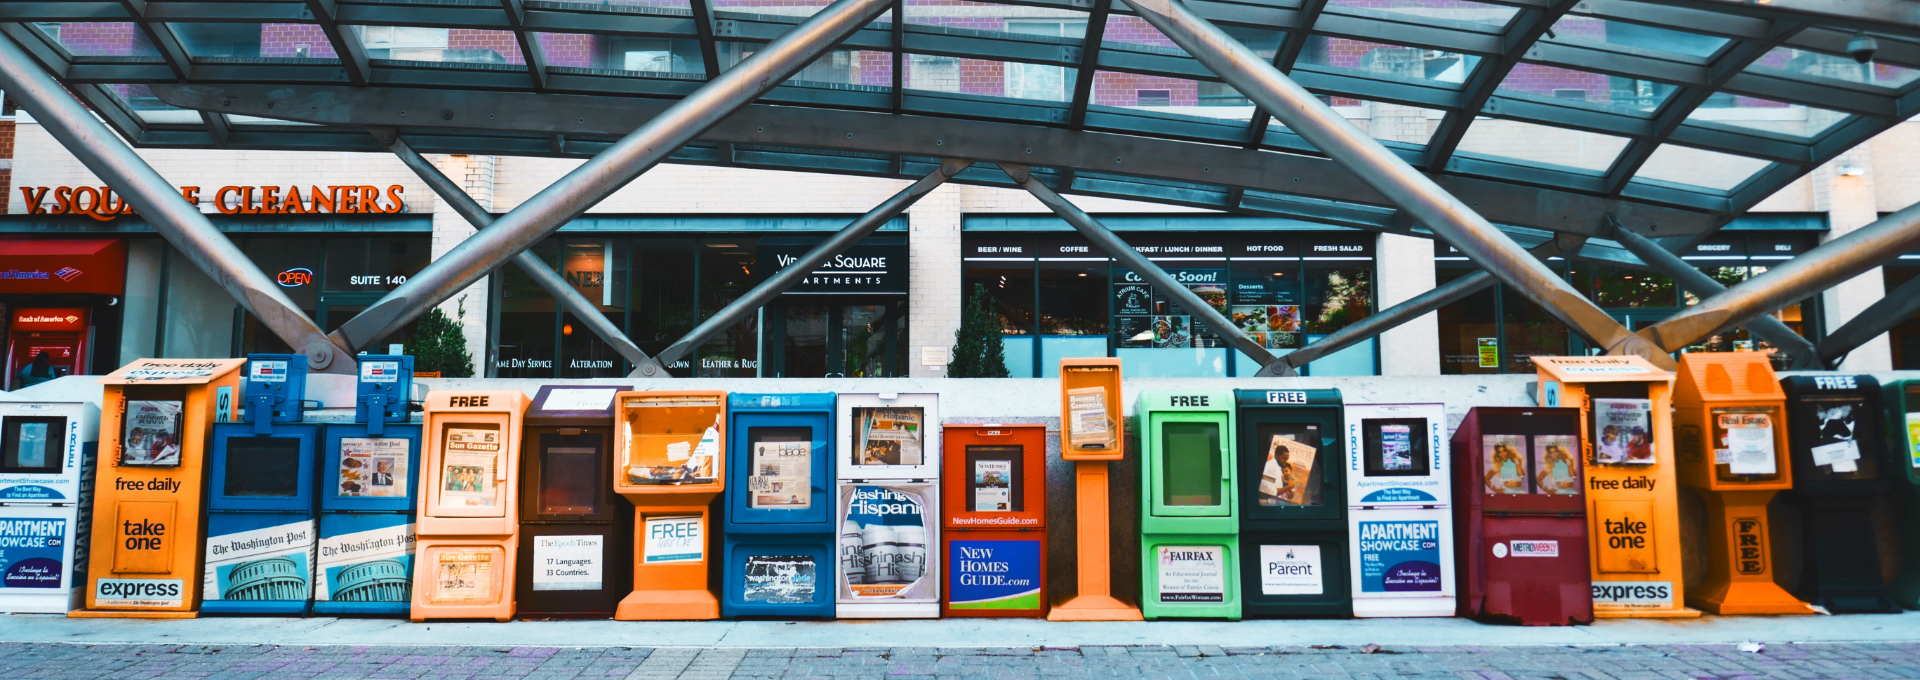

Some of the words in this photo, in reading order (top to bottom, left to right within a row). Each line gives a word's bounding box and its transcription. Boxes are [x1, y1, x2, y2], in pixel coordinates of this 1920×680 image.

[214, 185, 404, 214] CLEANERS
[835, 254, 886, 268] SQUARE
[13, 269, 50, 279] America
[278, 271, 312, 285] OPEN
[350, 276, 380, 284] SUITE
[386, 276, 406, 285] 140
[1178, 272, 1217, 282] Soon!
[802, 277, 881, 285] ARTMENTS
[1117, 286, 1135, 299] ATRIUM
[1136, 286, 1150, 299] CAFE
[180, 362, 222, 370] daily
[570, 359, 613, 368] ALTERATION
[702, 358, 732, 368] LEATHER
[1814, 376, 1858, 389] FREE
[450, 396, 489, 407] FREE
[1171, 396, 1209, 406] FREE
[1270, 392, 1305, 402] FREE
[67, 422, 77, 468] FREE
[116, 477, 144, 490] free
[147, 478, 181, 493] daily
[1590, 477, 1619, 490] free
[1622, 476, 1656, 491] daily
[74, 454, 96, 573] APARTMENT
[124, 519, 165, 536] take
[652, 522, 698, 539] FREE
[1361, 523, 1438, 540] APARTMENT
[1604, 517, 1646, 534] take
[126, 537, 161, 550] one
[212, 544, 228, 555] The
[231, 536, 284, 552] Washington
[287, 531, 306, 546] Post
[322, 546, 337, 557] The
[396, 534, 416, 549] Post
[554, 540, 576, 548] Epoch
[1609, 536, 1645, 549] one
[1738, 521, 1760, 572] FREE
[1170, 552, 1213, 560] FAIRFAX
[1269, 562, 1313, 575] Parent
[100, 582, 178, 598] express
[1592, 585, 1668, 601] express
